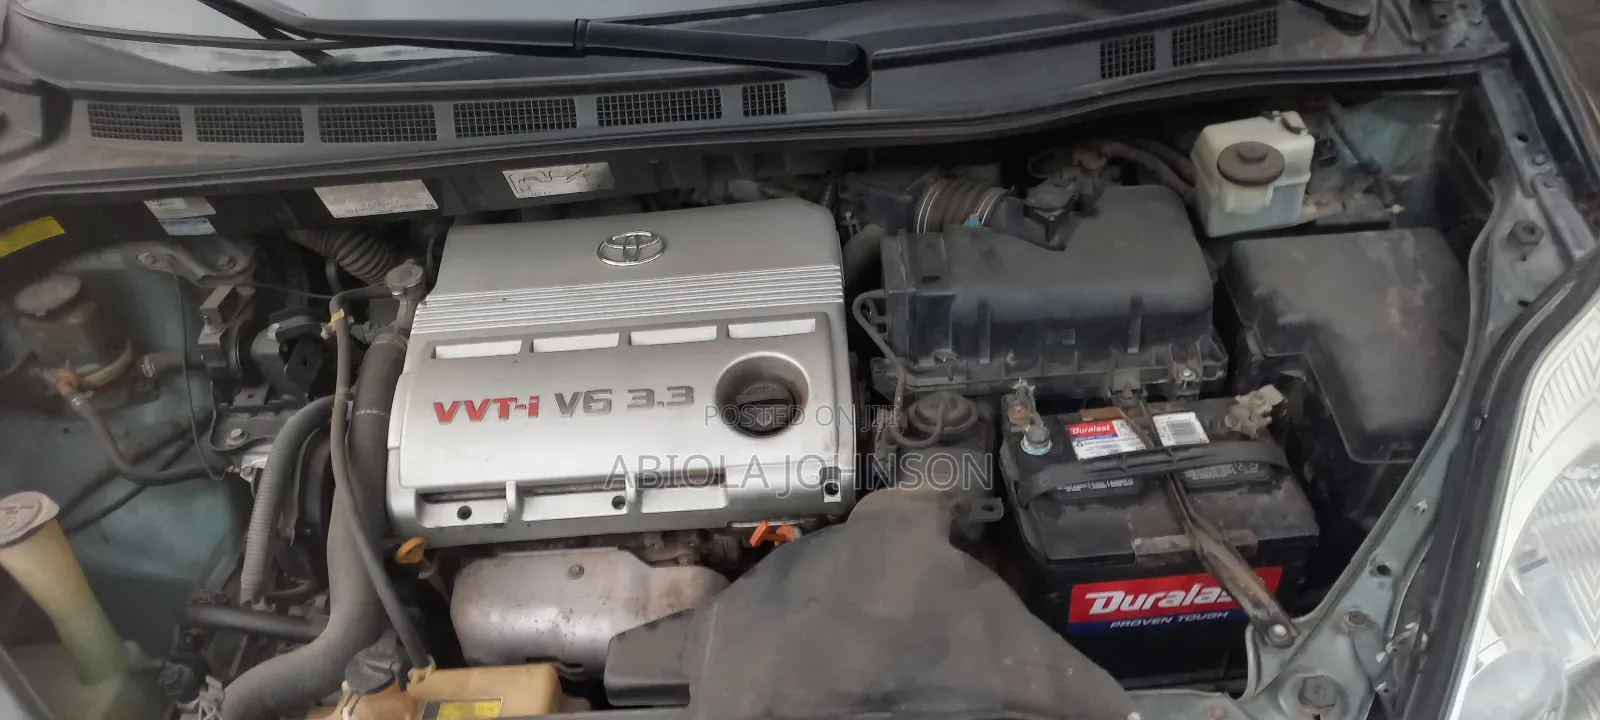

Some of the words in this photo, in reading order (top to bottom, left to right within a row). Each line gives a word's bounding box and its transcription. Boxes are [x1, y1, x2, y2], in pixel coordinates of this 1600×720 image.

[433, 395, 540, 426] VVT-i
[553, 388, 613, 419] V6
[626, 385, 695, 411] 3.3
[1072, 425, 1110, 434] Duralast
[1085, 583, 1233, 615] Durala
[1110, 616, 1172, 629] PROVEN
[1177, 611, 1228, 623] TOUGH
